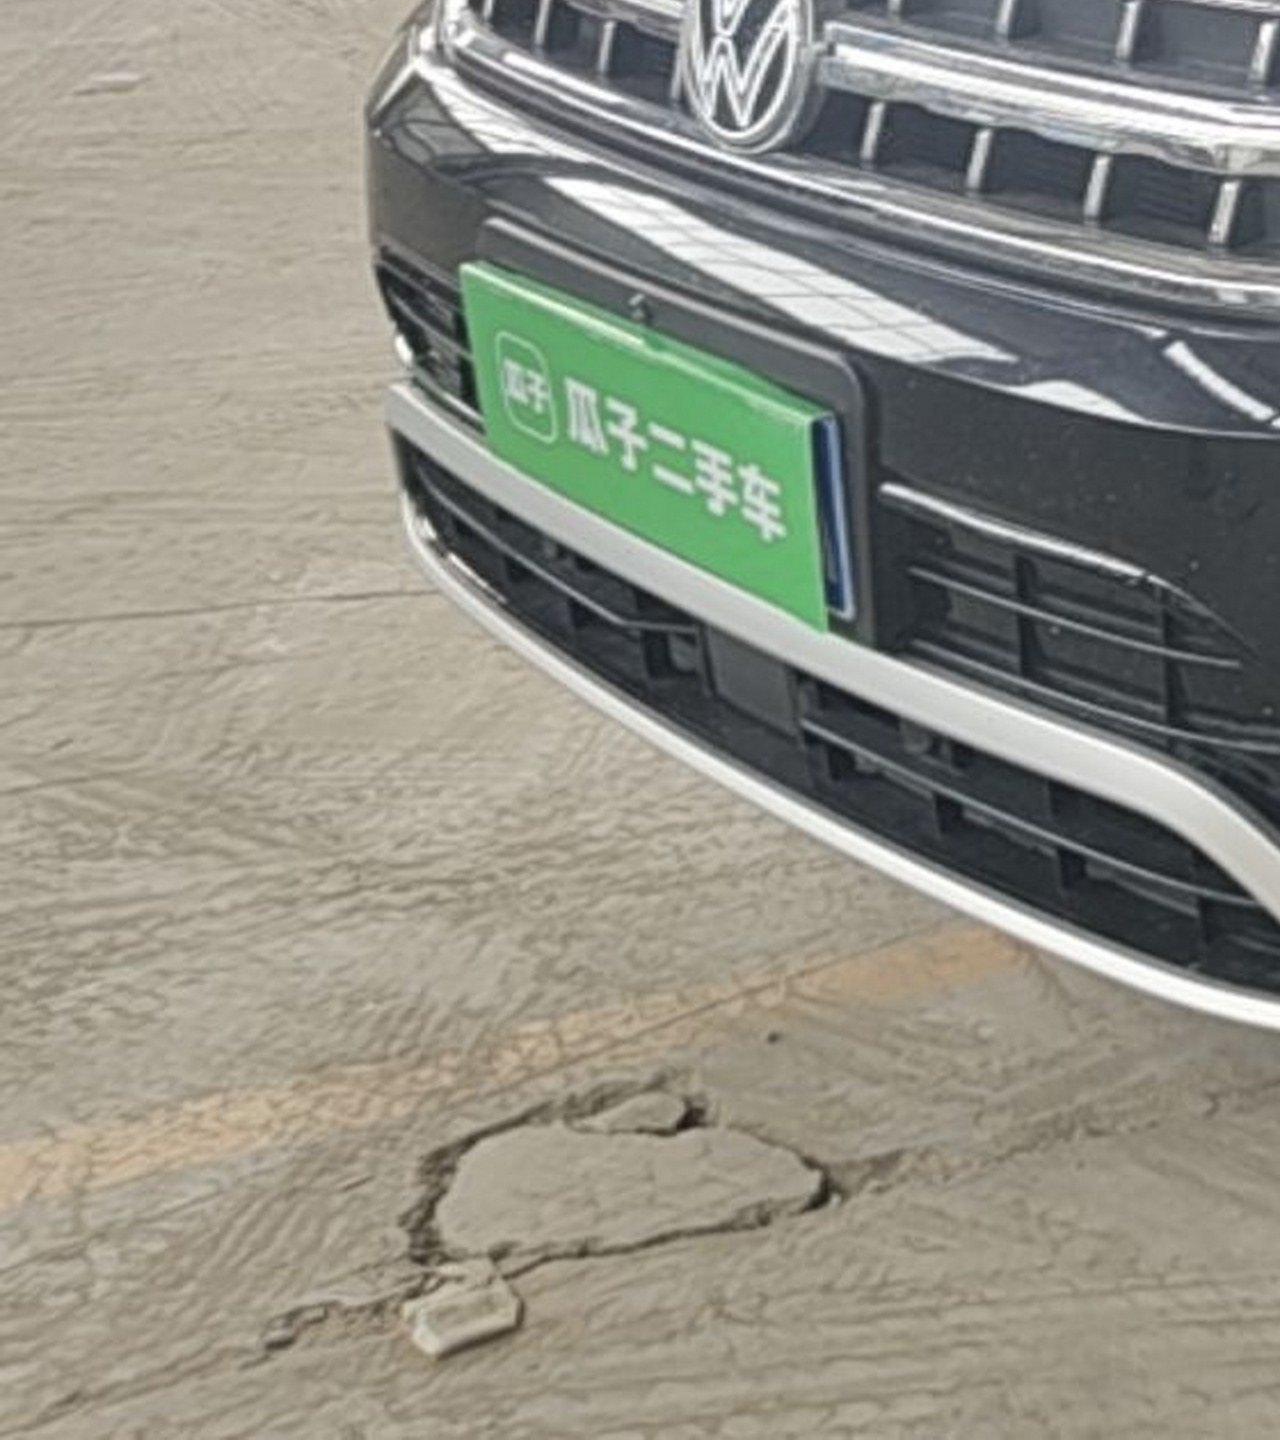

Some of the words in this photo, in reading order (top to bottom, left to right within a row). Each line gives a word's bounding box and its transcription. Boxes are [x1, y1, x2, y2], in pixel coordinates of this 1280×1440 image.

[563, 376, 788, 543] 瓜子二手车
